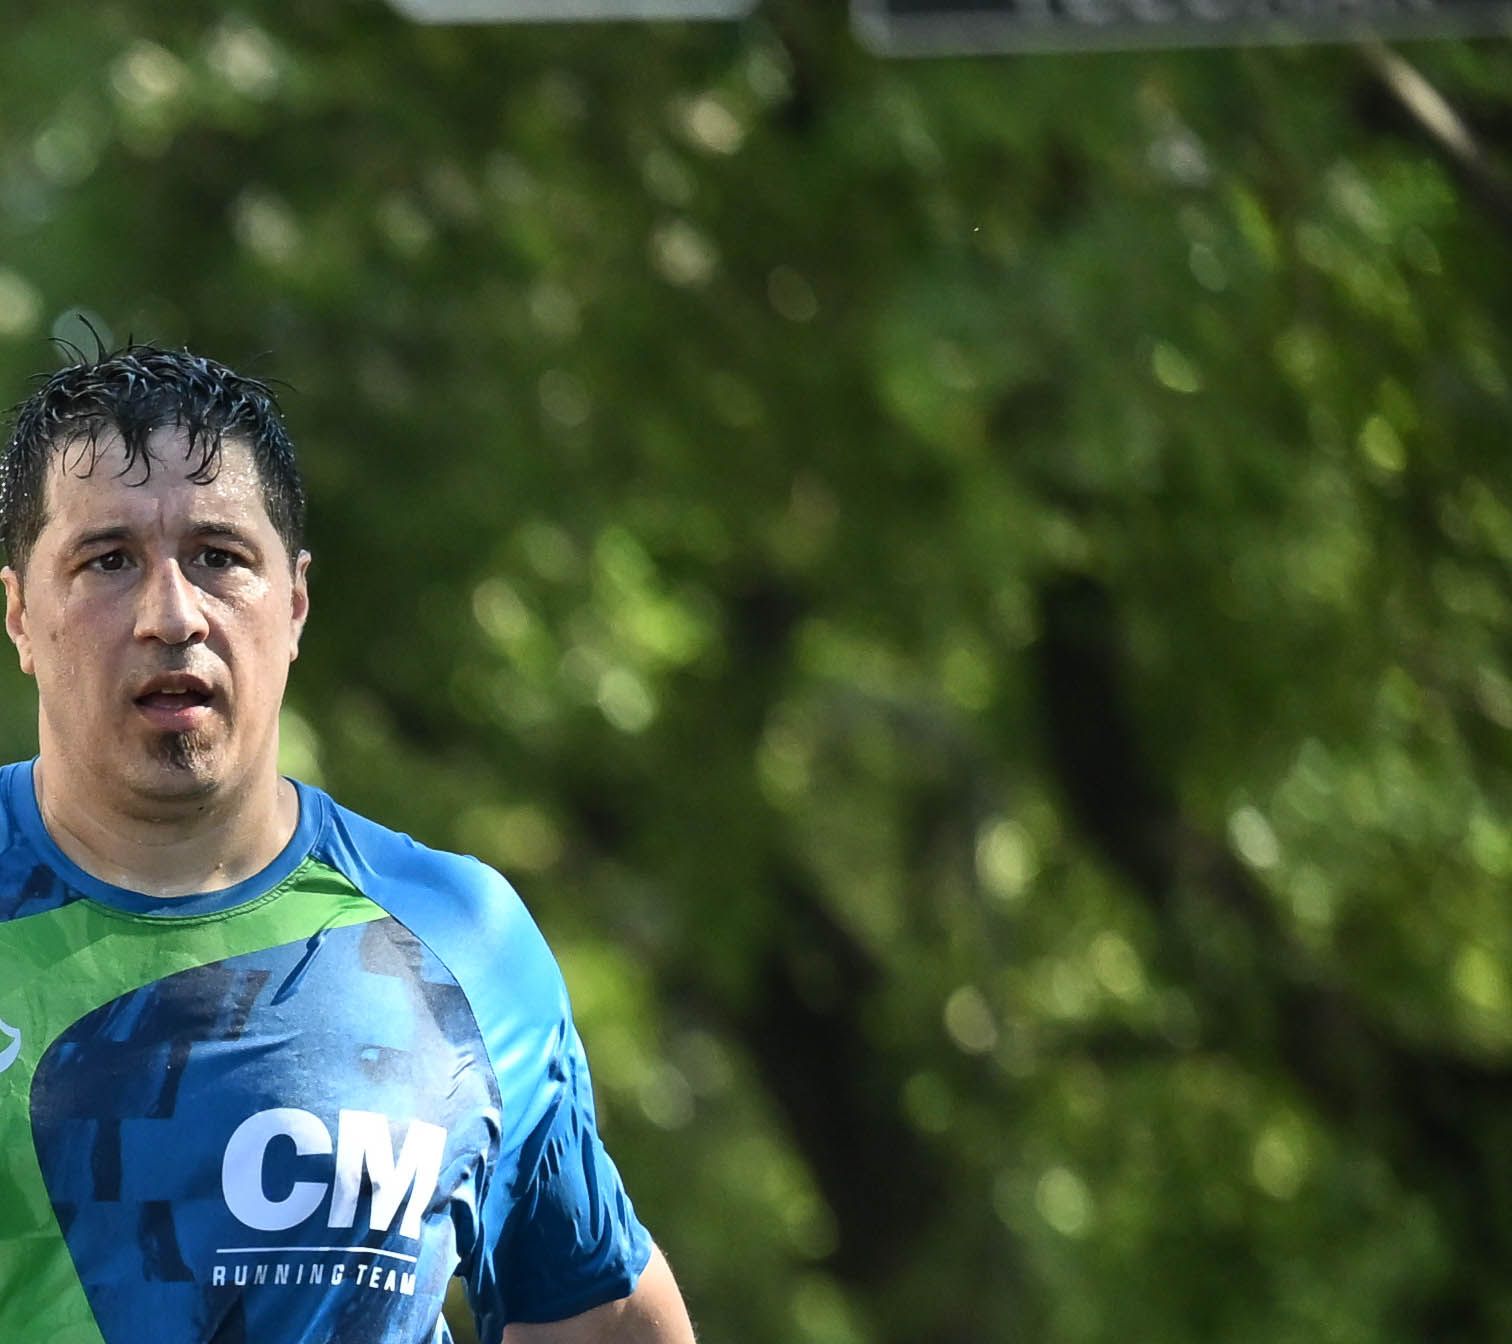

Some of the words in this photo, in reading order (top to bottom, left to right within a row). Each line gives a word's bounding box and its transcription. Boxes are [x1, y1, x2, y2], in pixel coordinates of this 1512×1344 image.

[221, 1107, 448, 1240] CM
[212, 1263, 345, 1287] RUNNING
[356, 1264, 417, 1297] TEAM
